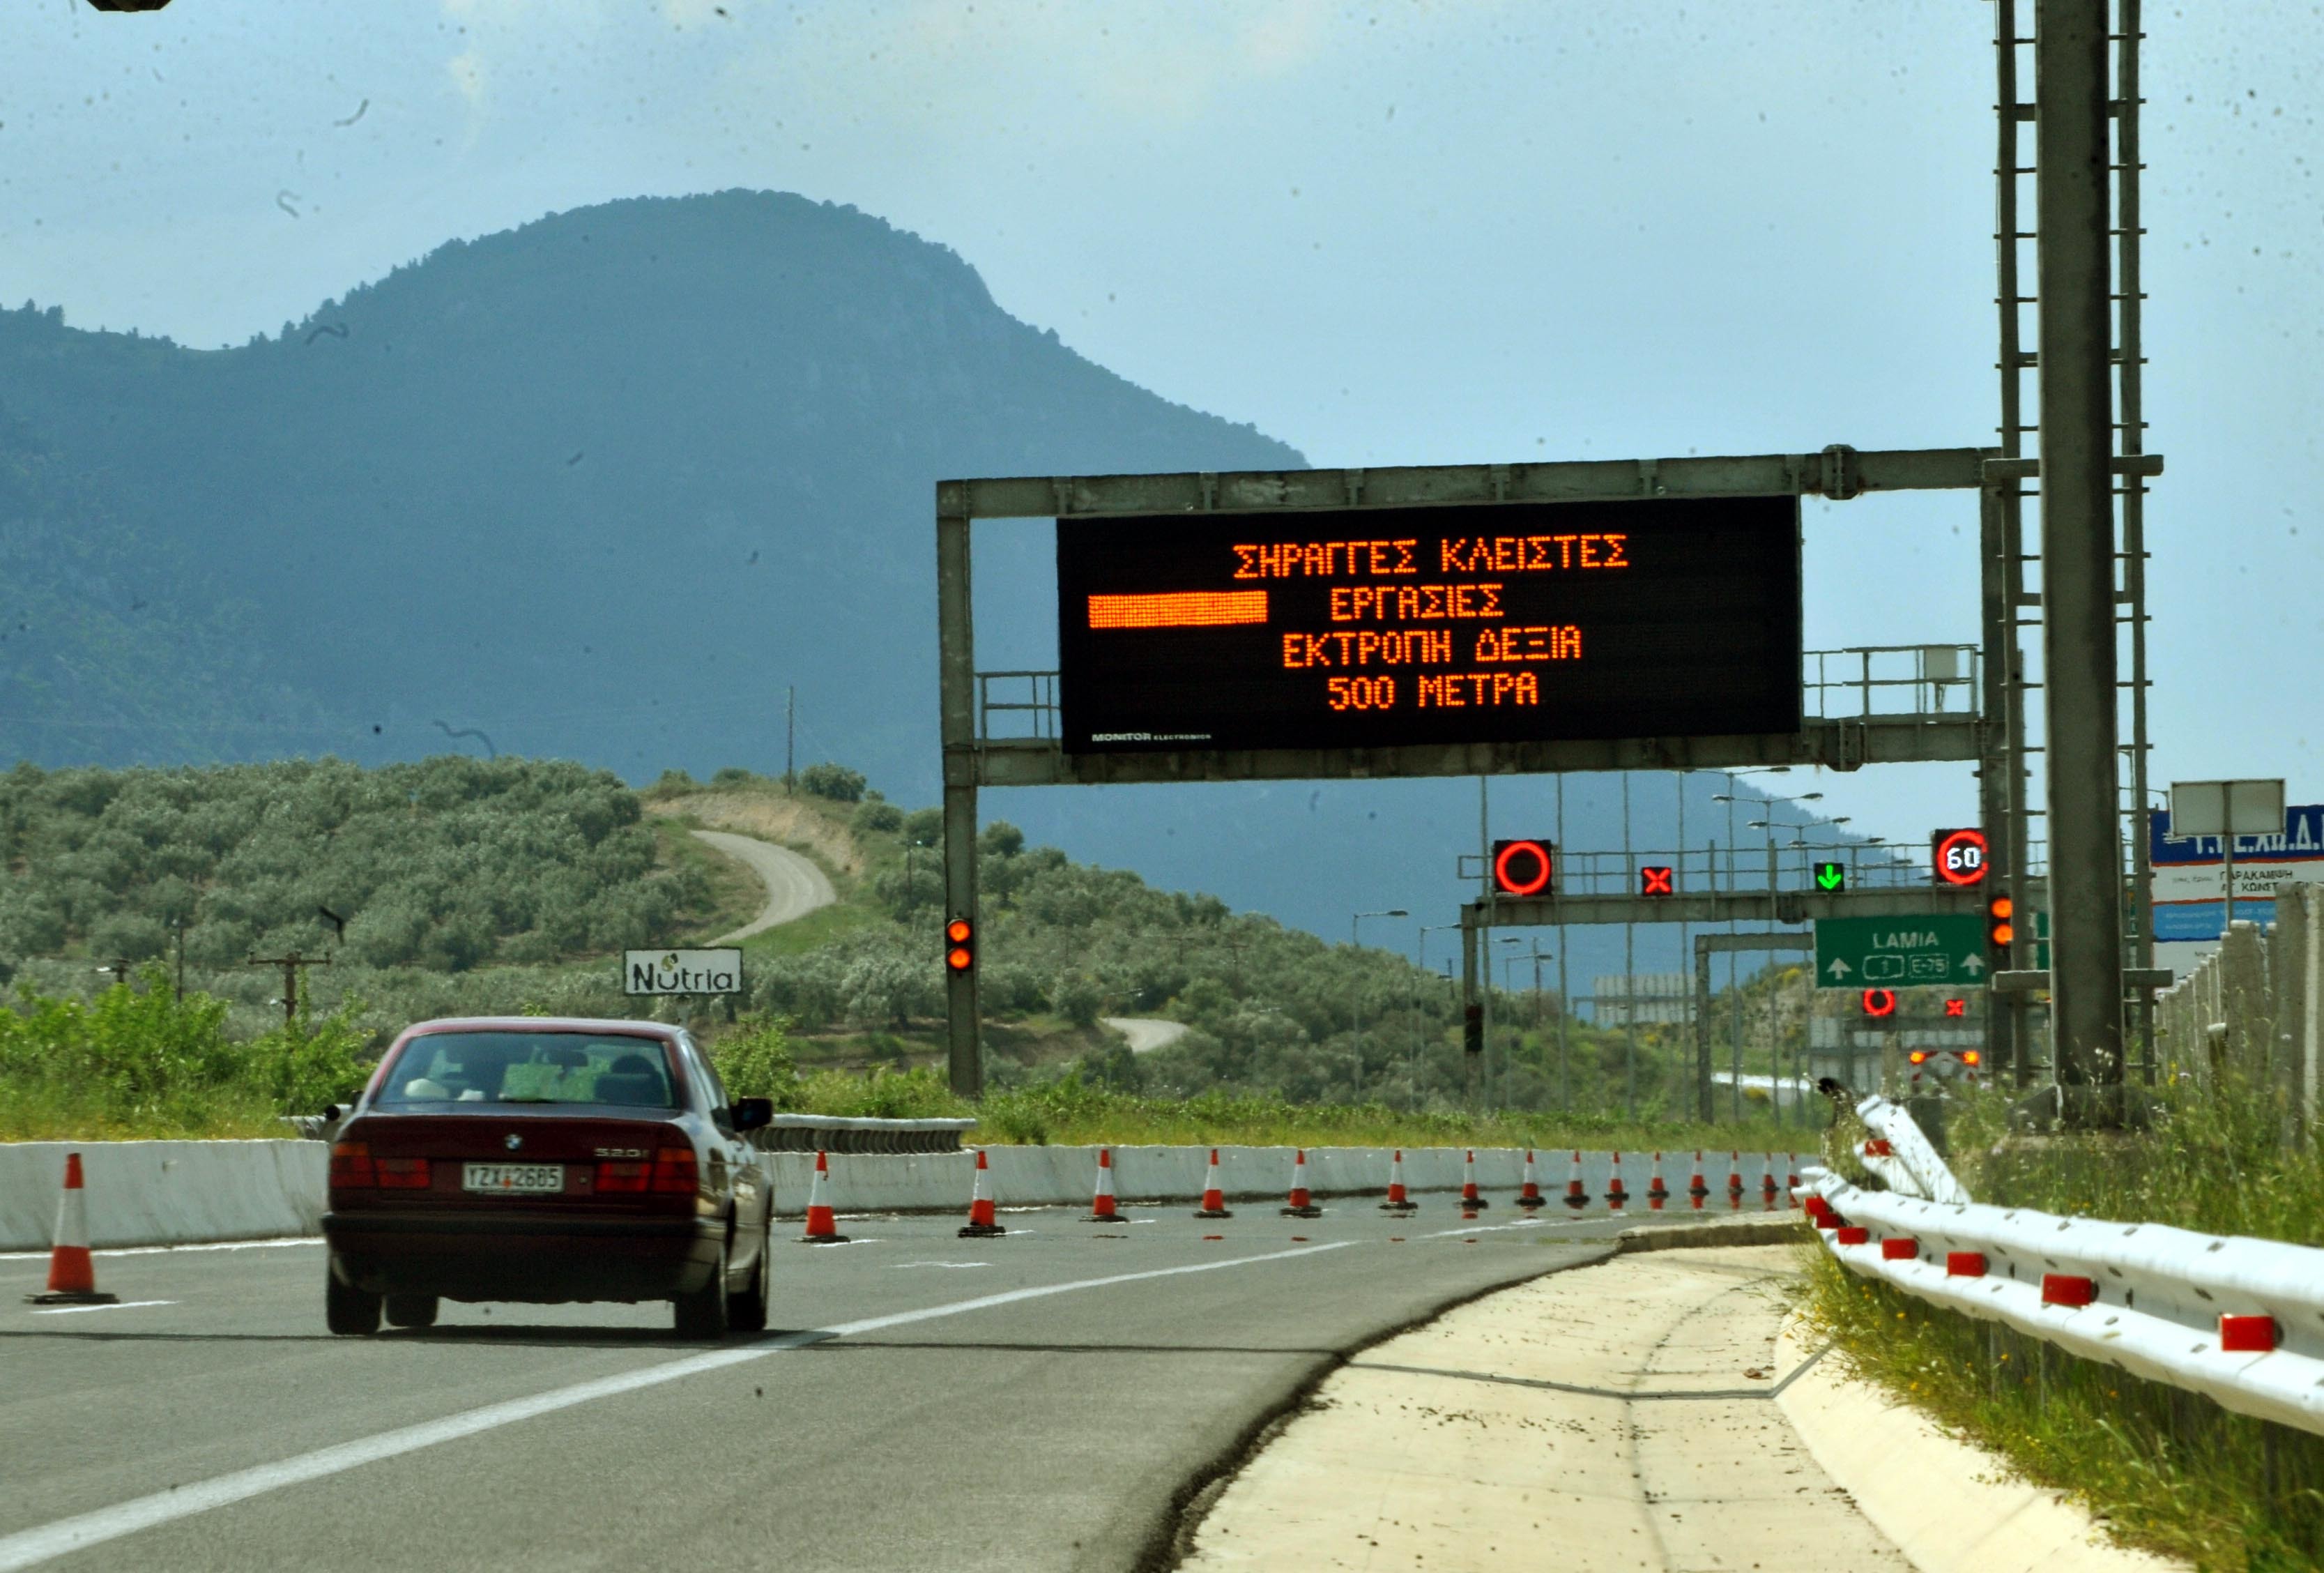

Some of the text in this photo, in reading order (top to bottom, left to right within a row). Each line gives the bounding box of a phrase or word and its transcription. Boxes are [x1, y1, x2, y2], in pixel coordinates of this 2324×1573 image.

[1233, 534, 1628, 579] ΣΗΡΑΓΓΕΣ ΚΛΕΙΣΤΕΣ
[1331, 584, 1504, 621] ΕΡΓΑΣΙΕΣ
[1283, 625, 1581, 668] ΕΚΤΡΟΠΗ ΔΕΞΙΑ
[1328, 671, 1538, 710] 500 ΜΕΤΡΑ
[1091, 733, 1151, 742] MONITOR
[1947, 847, 1981, 869] 60
[1872, 932, 1939, 949] LAMIA
[633, 962, 734, 991] Nutria
[1911, 958, 1945, 973] E-75
